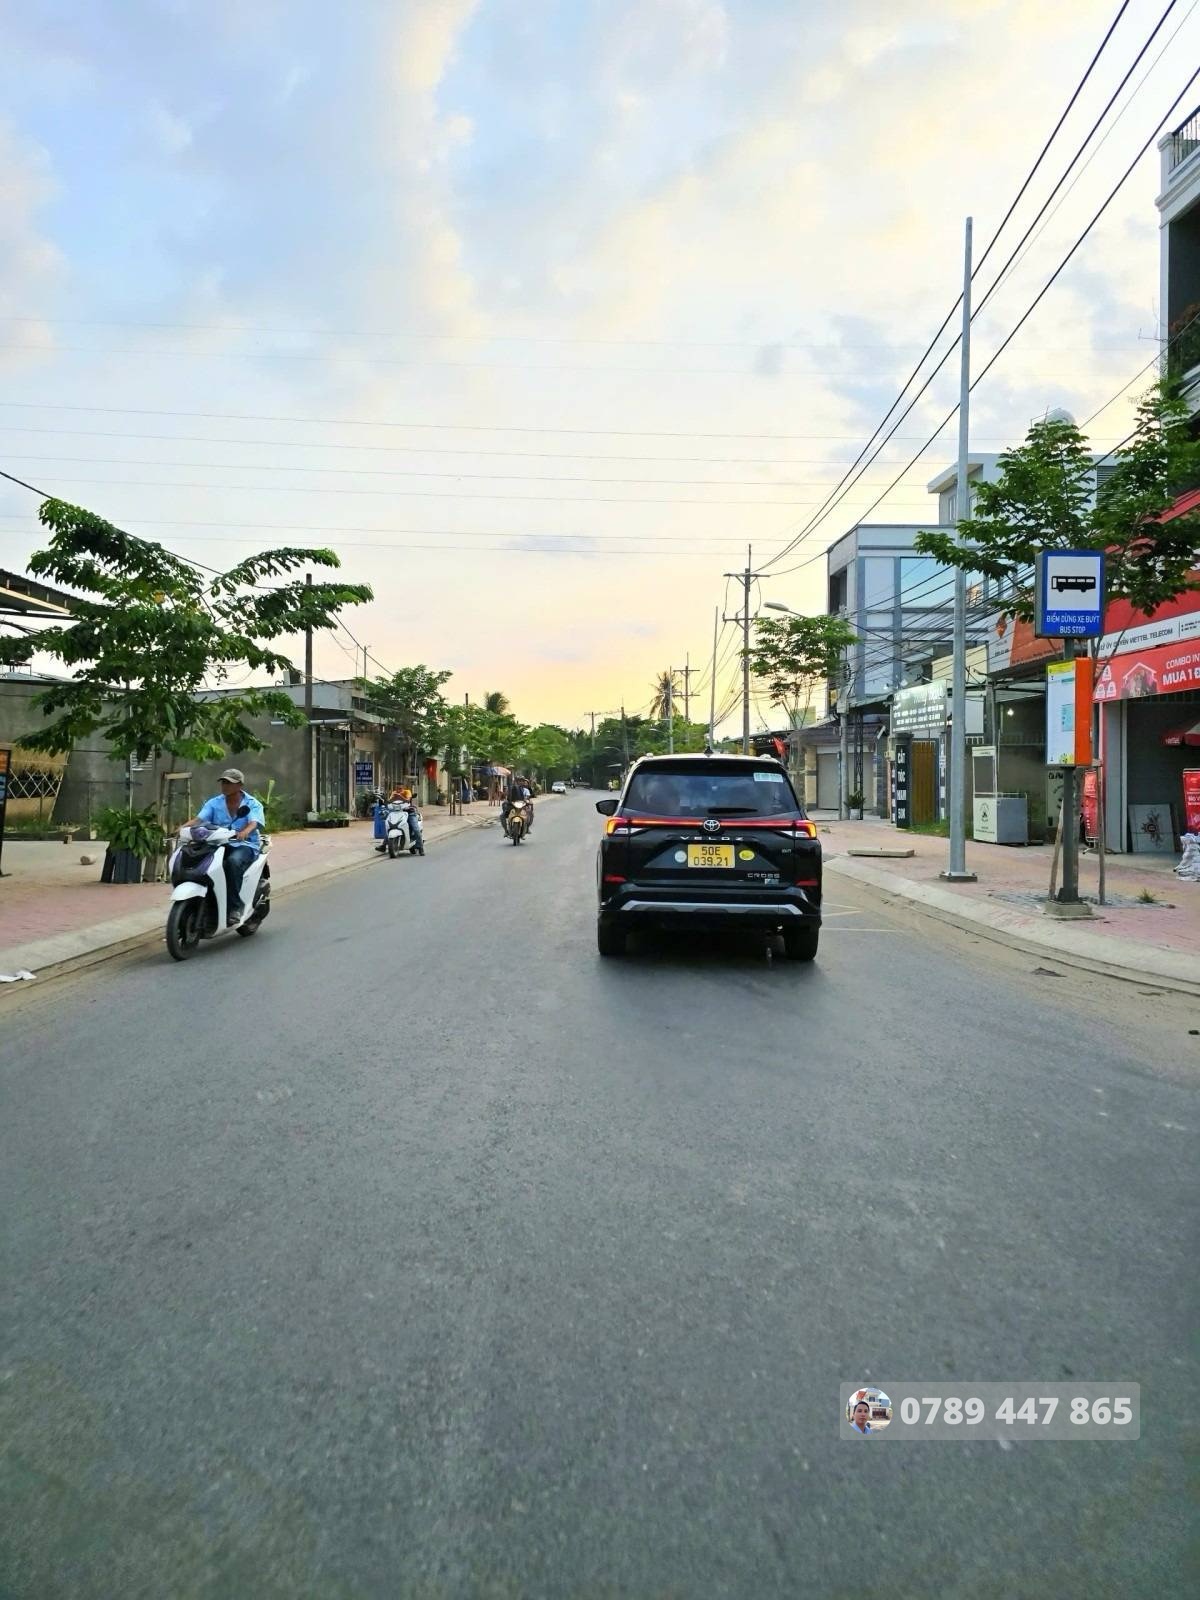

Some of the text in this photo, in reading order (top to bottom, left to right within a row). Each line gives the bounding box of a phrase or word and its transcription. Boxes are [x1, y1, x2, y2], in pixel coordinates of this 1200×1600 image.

[1077, 615, 1085, 623] XE
[1059, 625, 1086, 634] BUS STOP
[1129, 633, 1150, 644] VIETTEL
[1150, 628, 1173, 640] TELECOM
[1166, 655, 1191, 670] COMBO
[1162, 670, 1187, 686] MUA
[701, 846, 721, 856] 50E
[693, 857, 729, 867] 039.21
